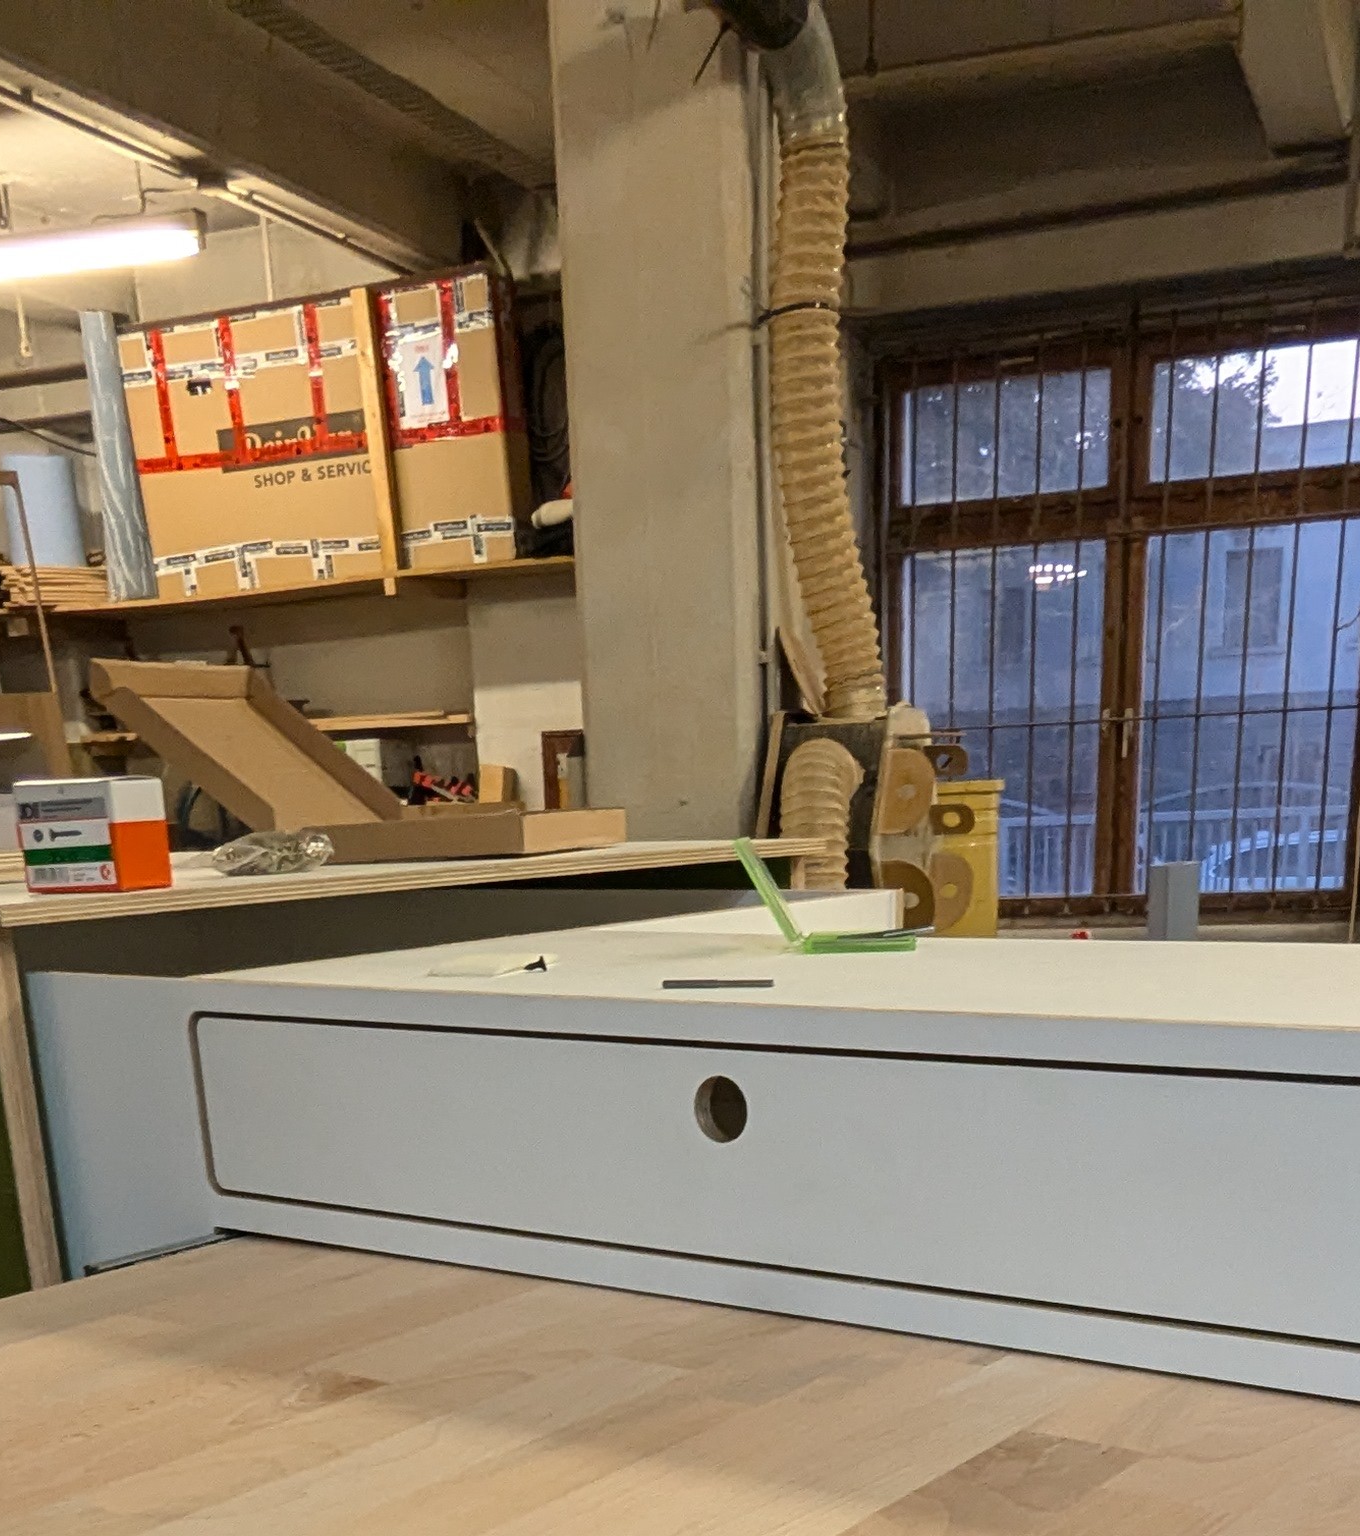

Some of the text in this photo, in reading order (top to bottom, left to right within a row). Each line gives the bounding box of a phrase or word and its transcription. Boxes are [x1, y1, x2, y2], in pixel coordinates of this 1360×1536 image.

[254, 459, 372, 489] SHOP & SERVIC
